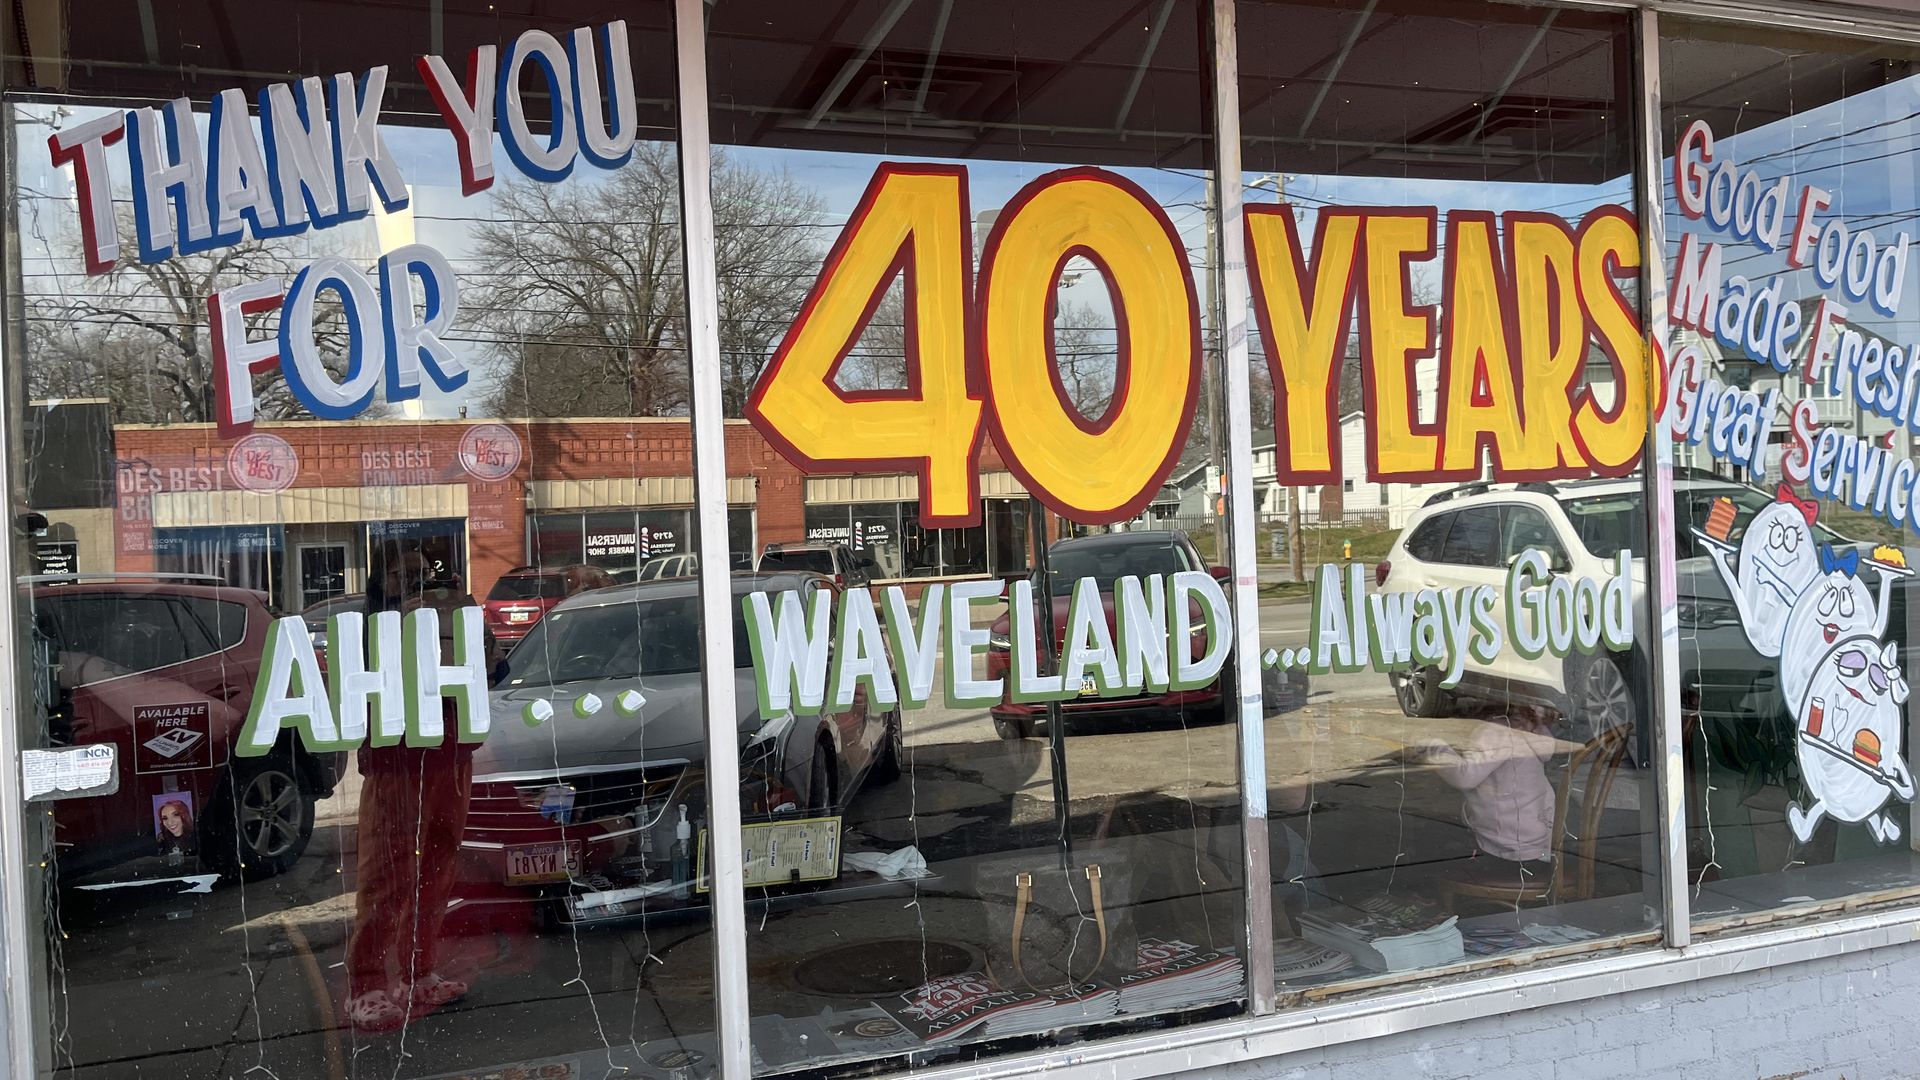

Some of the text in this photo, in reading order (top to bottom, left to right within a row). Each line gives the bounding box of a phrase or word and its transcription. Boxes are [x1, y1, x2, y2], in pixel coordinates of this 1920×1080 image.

[48, 20, 637, 276] THANK YOU
[1675, 120, 1909, 317] Good Food
[208, 244, 468, 440] FOR
[743, 161, 1668, 529] 40 YEARS
[1668, 233, 1801, 373] Made
[1670, 345, 1782, 480] Great
[119, 467, 225, 494] DES BEST
[362, 450, 432, 469] DES BEST
[236, 606, 491, 757] AHH
[742, 571, 1234, 720] WAVELAND
[1506, 548, 1634, 660] Good
[86, 748, 110, 758] NCN
[138, 706, 205, 719] AVAILABLE
[156, 717, 188, 728] HERE
[1121, 952, 1219, 984] CITYVIEW
[928, 992, 1036, 1034] CITYVIEW
